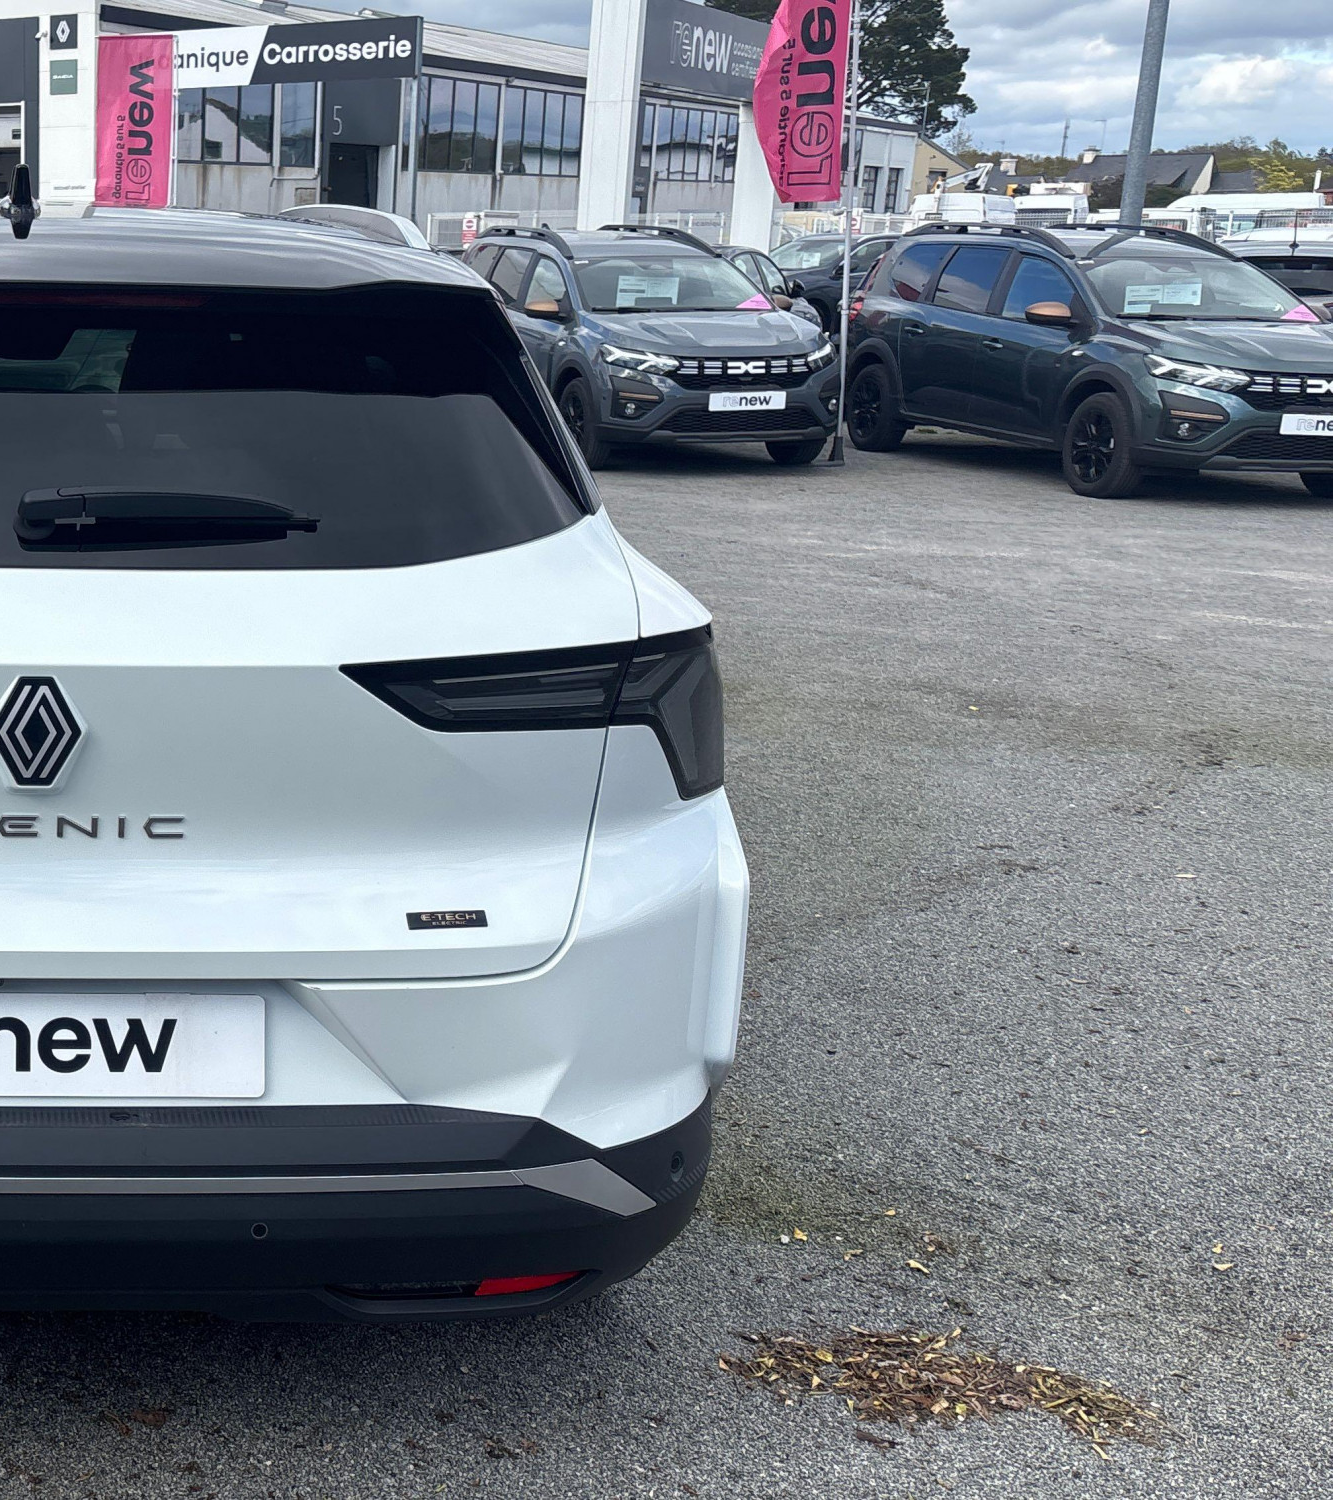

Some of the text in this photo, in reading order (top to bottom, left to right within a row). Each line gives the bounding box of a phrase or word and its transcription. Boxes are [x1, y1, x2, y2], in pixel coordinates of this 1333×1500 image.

[174, 46, 249, 72] anique
[263, 34, 412, 66] Carrosserie
[670, 20, 733, 74] renew
[332, 105, 343, 136] 5
[722, 395, 772, 408] renew
[420, 912, 477, 921] E-TECH
